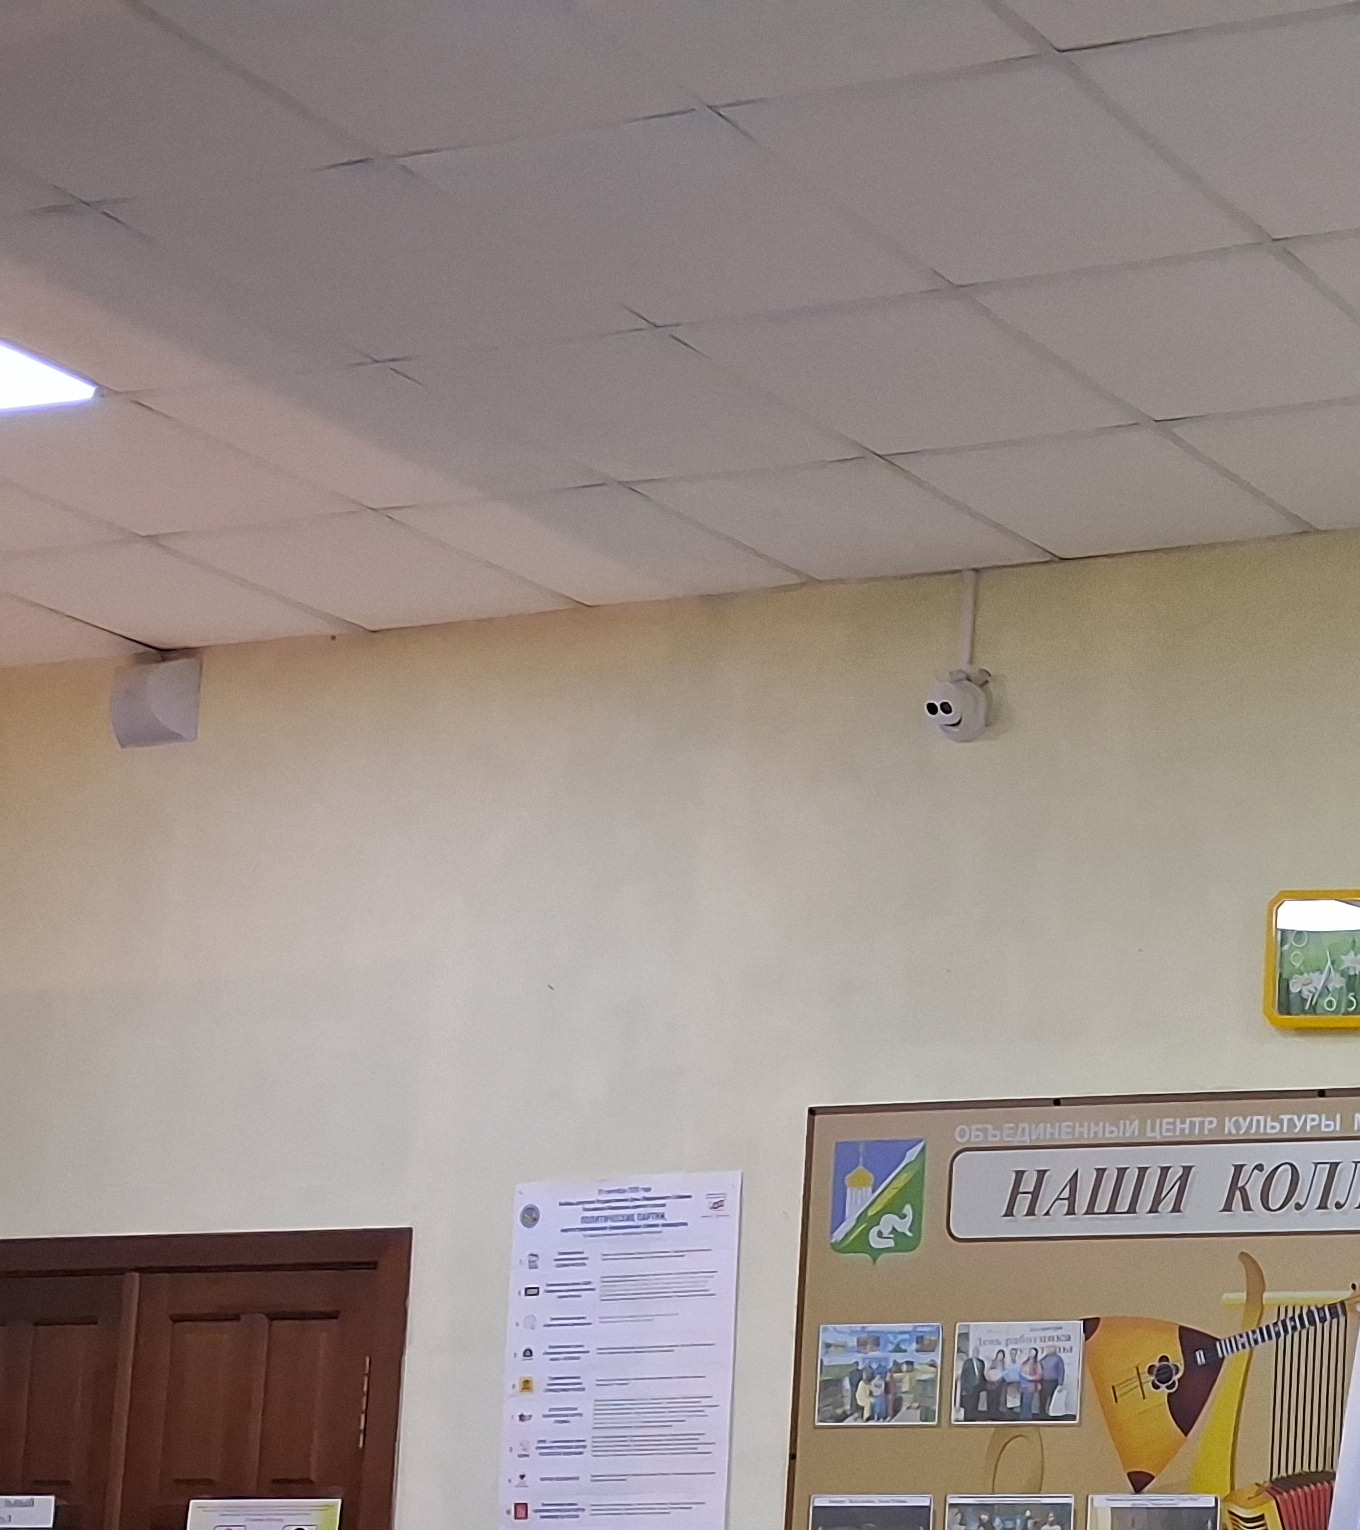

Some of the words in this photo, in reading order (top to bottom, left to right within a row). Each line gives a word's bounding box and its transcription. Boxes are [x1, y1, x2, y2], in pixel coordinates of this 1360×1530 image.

[954, 1119, 1140, 1144] ОБЪЕДИНЕННЫЙ
[1145, 1116, 1218, 1140] ЦЕНТР
[1224, 1113, 1342, 1135] КУЛЬТУРЫ
[1001, 1163, 1197, 1218] НАШИ
